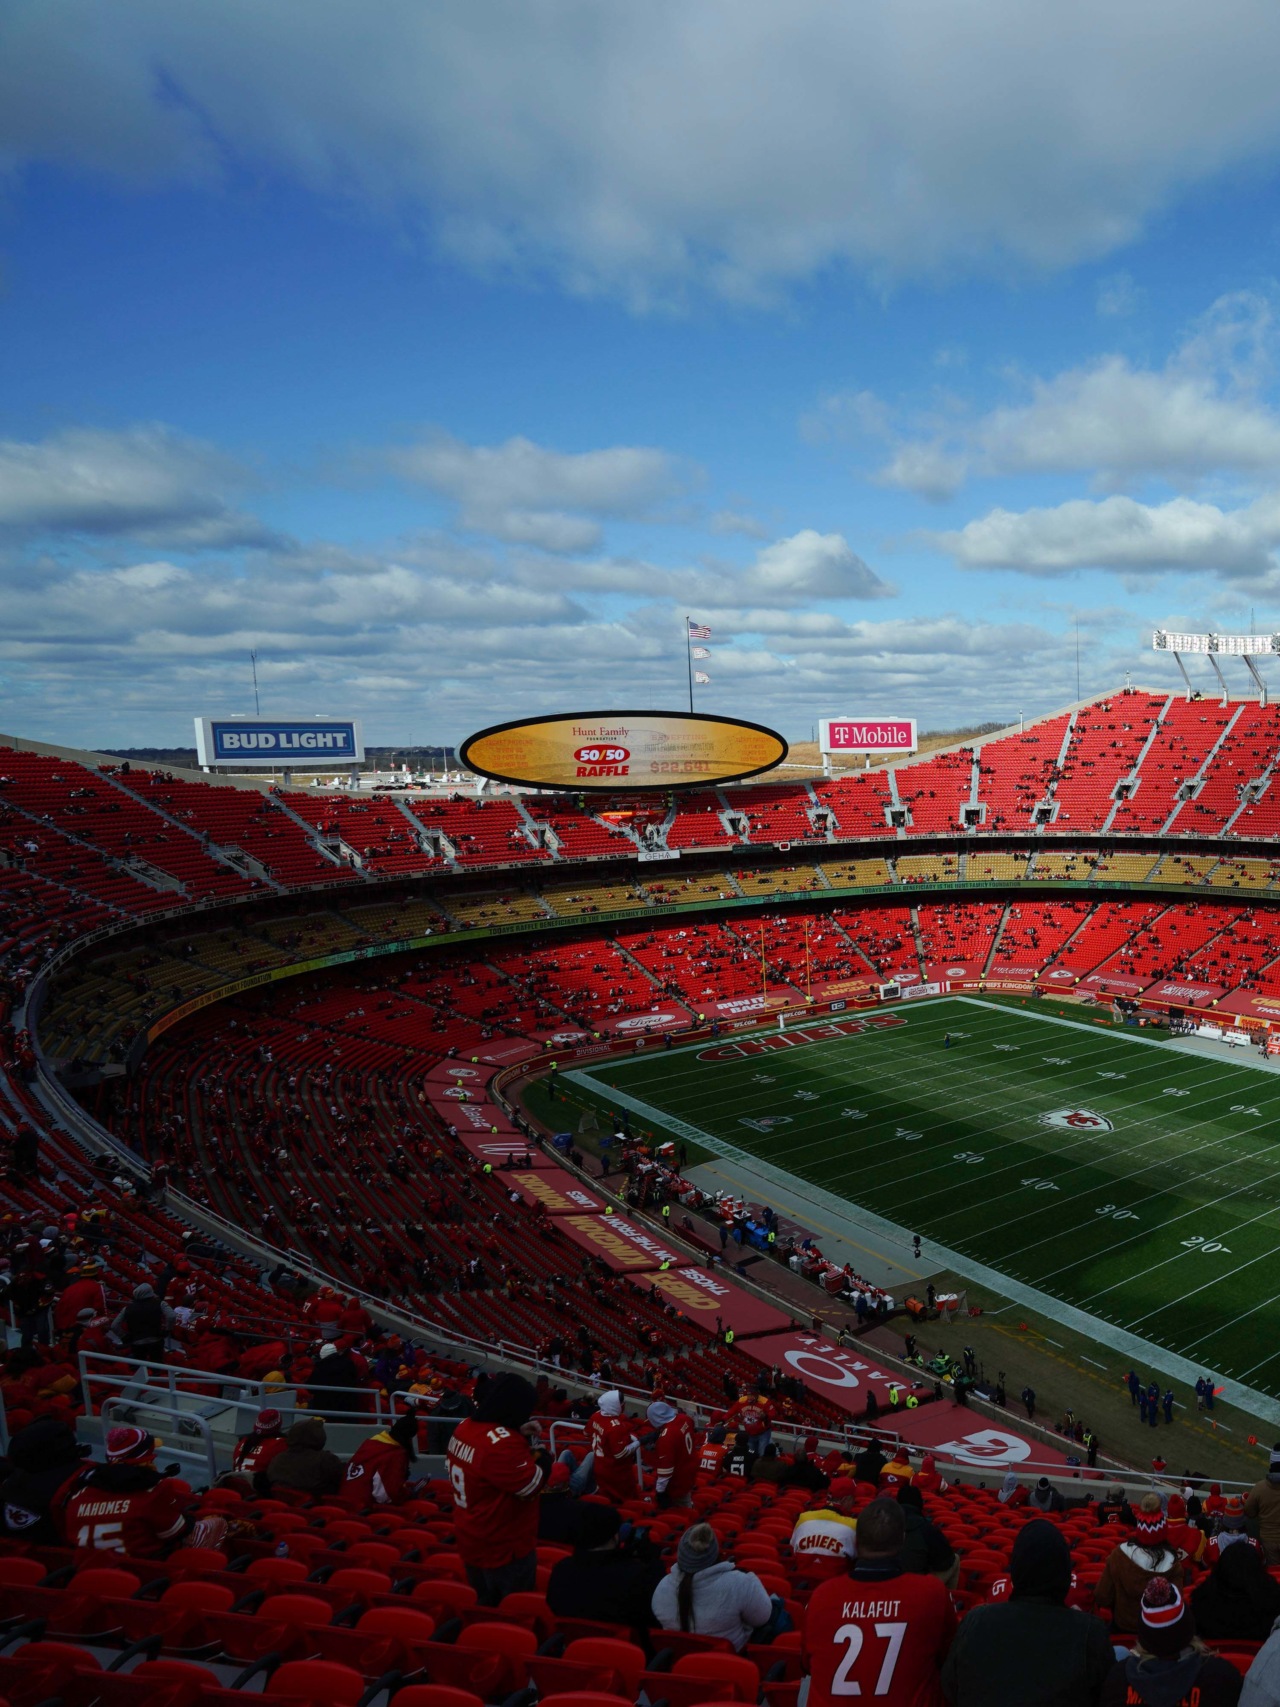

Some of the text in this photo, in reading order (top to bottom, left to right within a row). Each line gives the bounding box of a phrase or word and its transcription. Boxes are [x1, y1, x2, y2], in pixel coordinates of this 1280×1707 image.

[572, 726, 629, 739] Hunt Family
[852, 727, 907, 744] Mobile
[222, 733, 346, 749] BUD LIGHT
[580, 749, 624, 761] 50/50
[576, 766, 629, 777] RAFFLE
[645, 852, 672, 860] GEHA
[640, 907, 677, 916] FOUNDATION
[820, 983, 881, 997] KINGDOM
[826, 980, 865, 990] CHIEFS
[1002, 982, 1037, 990] KINGDOM
[717, 996, 765, 1010] RUN IT
[730, 1002, 771, 1014] BACK
[696, 1014, 909, 1061] CHIEFS
[576, 1044, 611, 1056] DIVISIONAL
[841, 1108, 868, 1120] 30
[895, 1128, 923, 1141] 40
[953, 1151, 984, 1164] 50
[511, 1173, 576, 1210] HONORS
[1021, 1177, 1054, 1190] 40
[566, 1190, 599, 1208] LINES
[1095, 1204, 1132, 1220] 30
[564, 1216, 654, 1265] KINGDOM
[598, 1214, 678, 1263] ON THE FRONT
[1180, 1236, 1223, 1253] 20
[678, 1268, 731, 1296] THOSE
[641, 1272, 721, 1311] CHIEFS
[485, 1426, 509, 1446] 19
[730, 1464, 746, 1478] 51
[77, 1500, 131, 1518] MAHOMES
[77, 1522, 126, 1554] 15
[798, 1535, 844, 1555] CHIEFS
[842, 1600, 901, 1619] KALAFUT
[830, 1622, 910, 1698] 27
